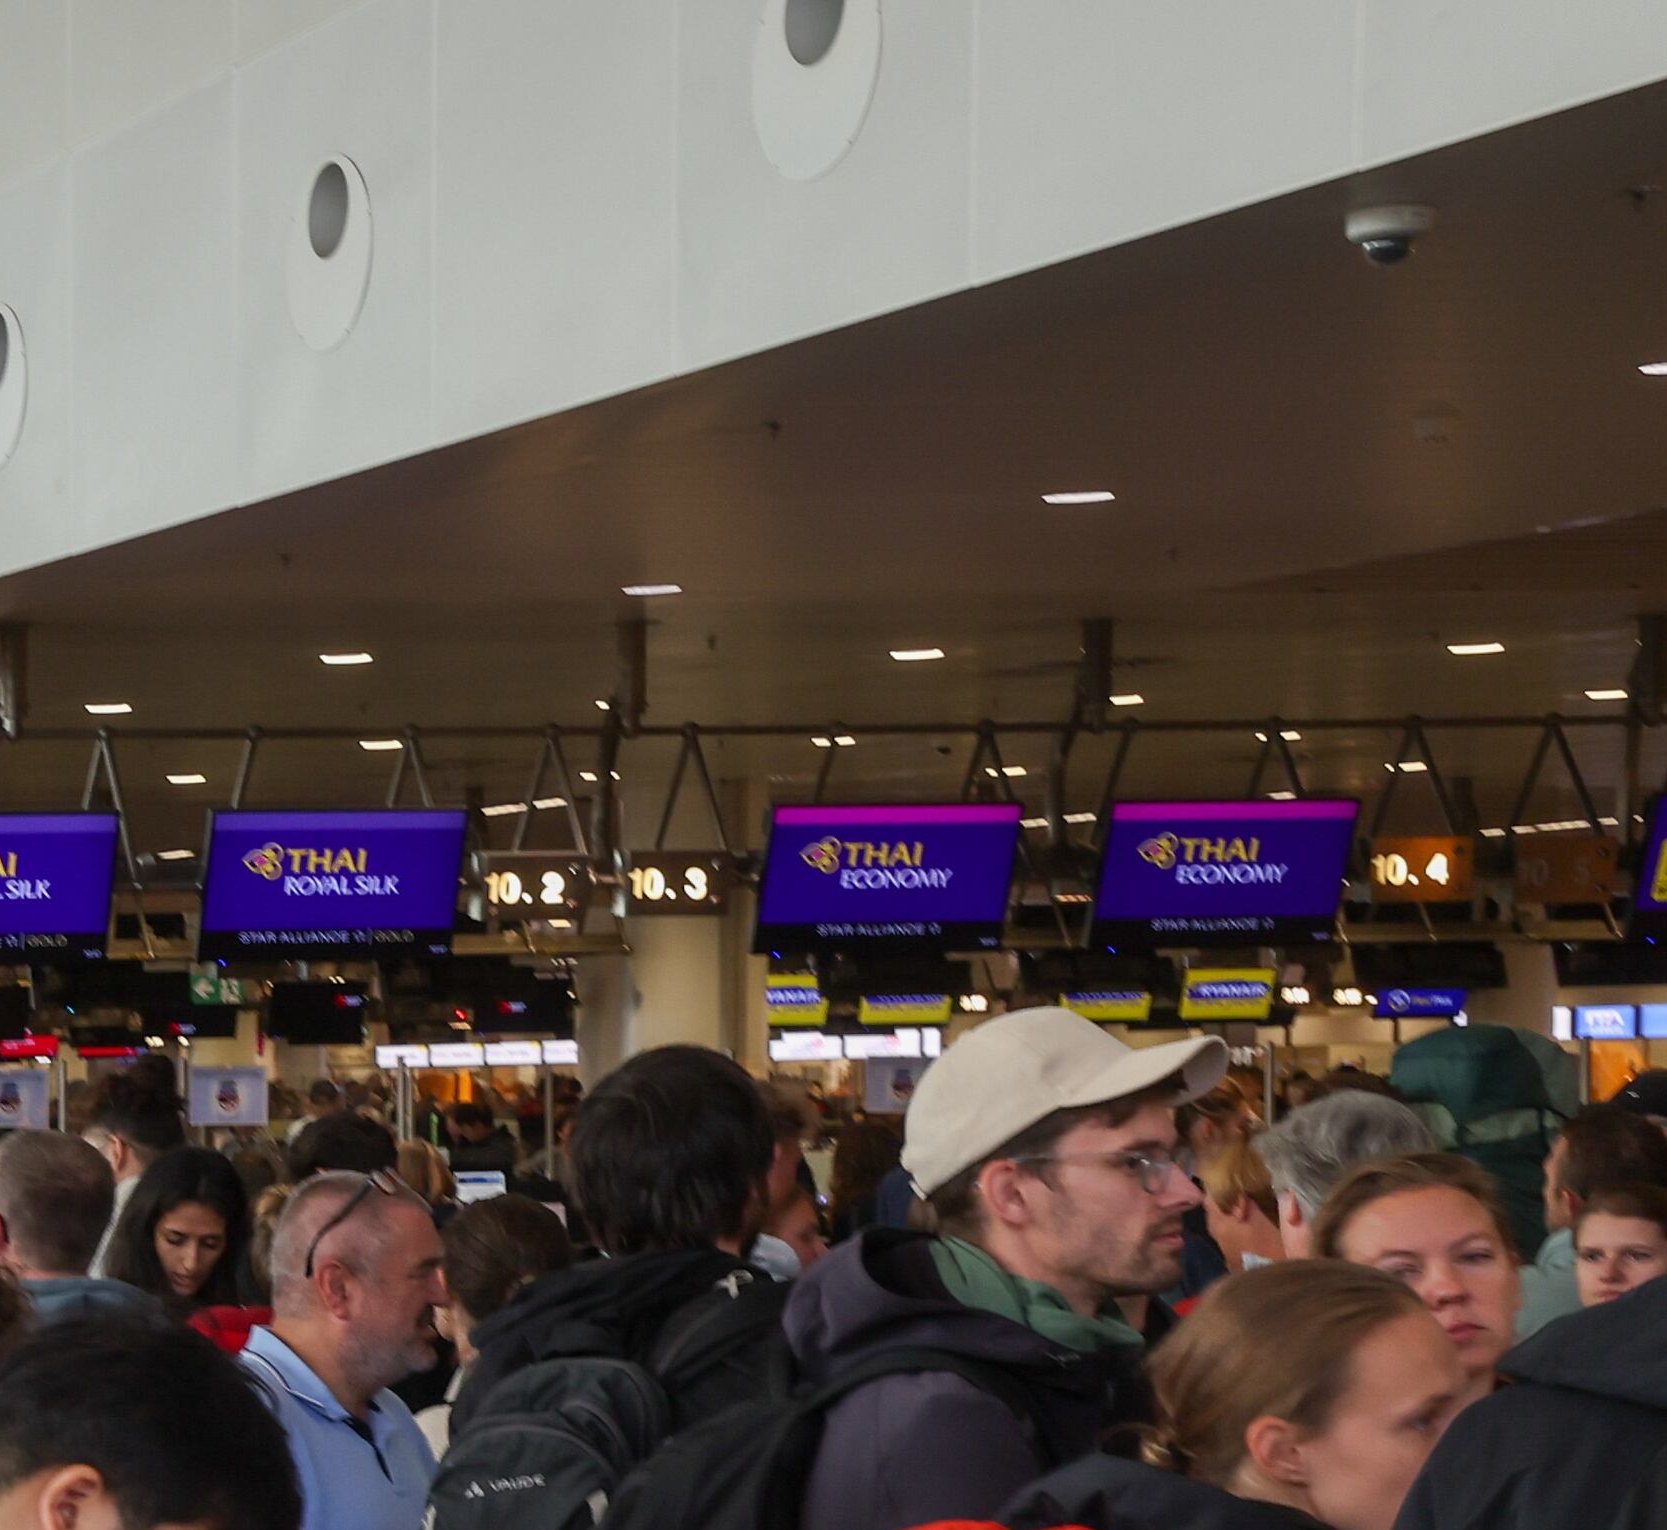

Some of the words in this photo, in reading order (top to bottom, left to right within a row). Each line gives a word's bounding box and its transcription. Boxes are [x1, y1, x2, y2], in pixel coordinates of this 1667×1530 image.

[286, 848, 368, 873] THAI
[843, 841, 924, 868] THAI
[1180, 837, 1261, 863] THAI
[284, 875, 352, 897] ROYAL
[354, 874, 400, 896] SILK
[840, 868, 954, 891] ECONOMY
[1175, 863, 1289, 886] ECONOMY
[6, 879, 52, 901] SILK
[816, 922, 854, 938] STAR
[856, 921, 927, 938] ALLIANCE
[1151, 918, 1190, 934] STAR
[1192, 916, 1262, 933] ALLIANCE
[26, 932, 69, 949] GOLD
[238, 929, 278, 945] STAR
[281, 928, 352, 945] ALLIANCE
[1197, 980, 1269, 999] RYANAIR
[487, 1472, 547, 1491] VAUDE
